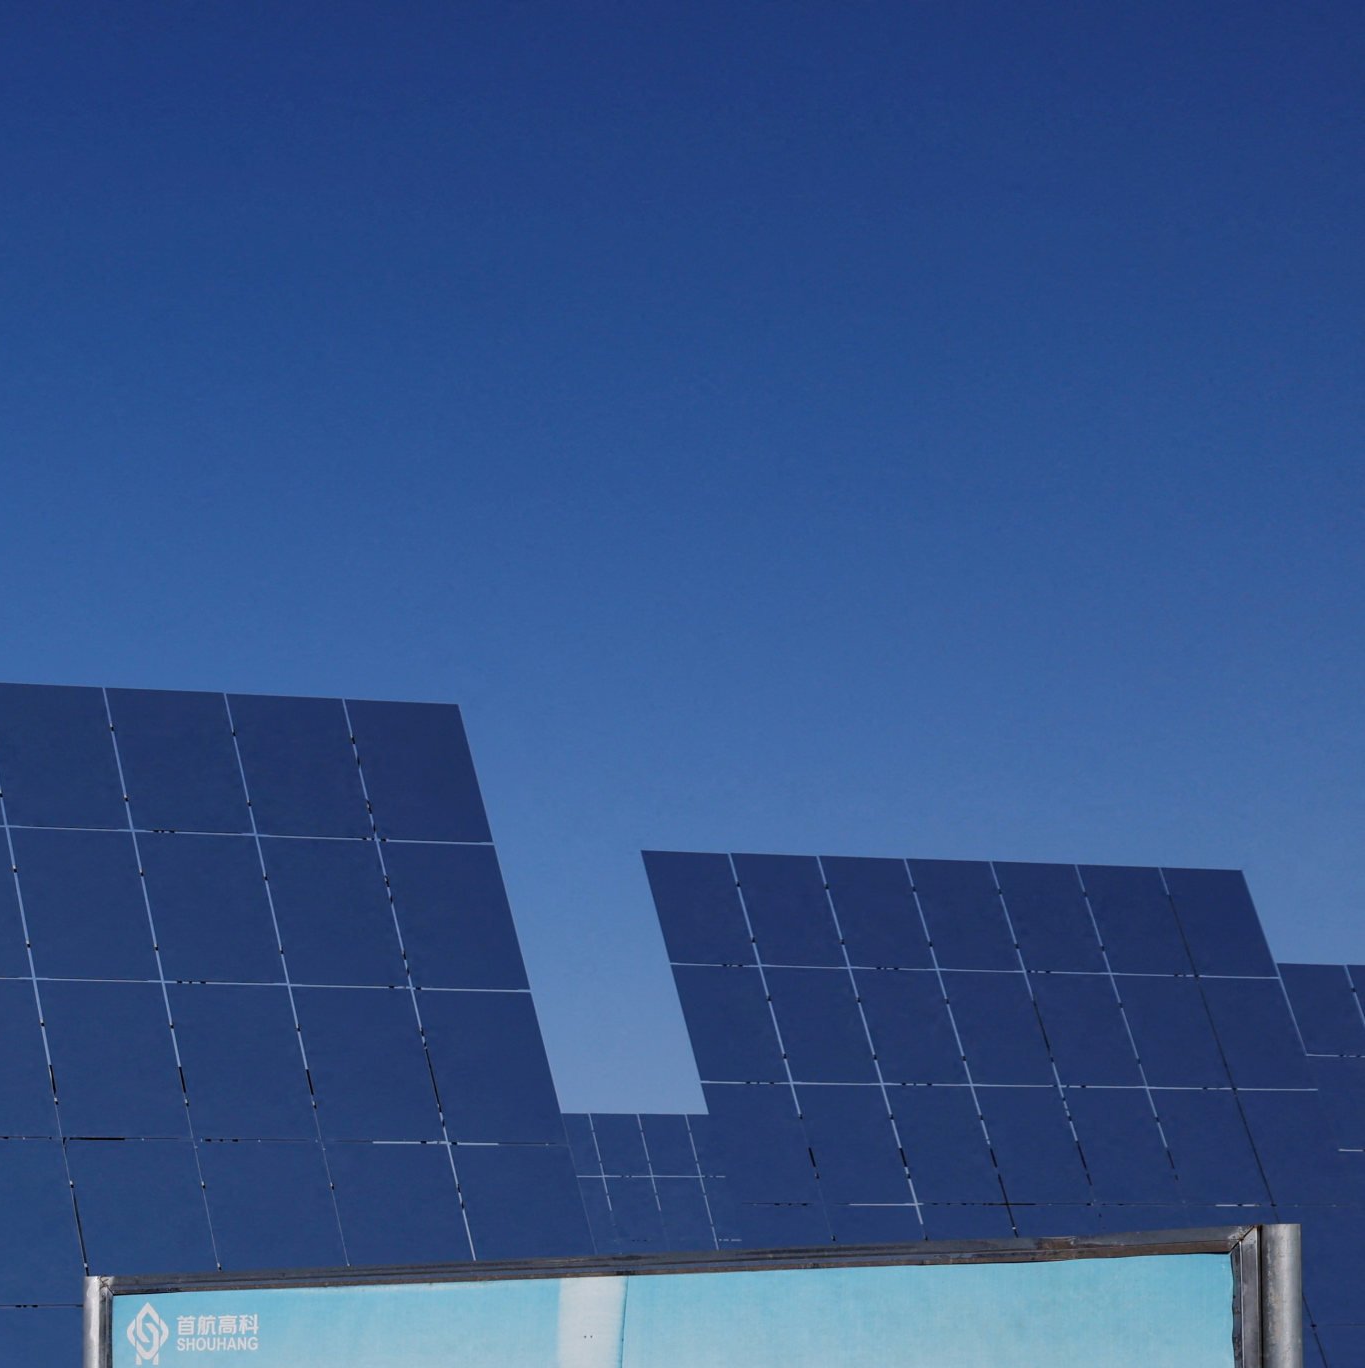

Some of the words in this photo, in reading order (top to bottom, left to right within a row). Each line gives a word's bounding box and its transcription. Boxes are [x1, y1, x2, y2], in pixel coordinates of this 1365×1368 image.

[177, 1314, 259, 1335] 首航高科
[177, 1337, 258, 1351] SHOUHANG
